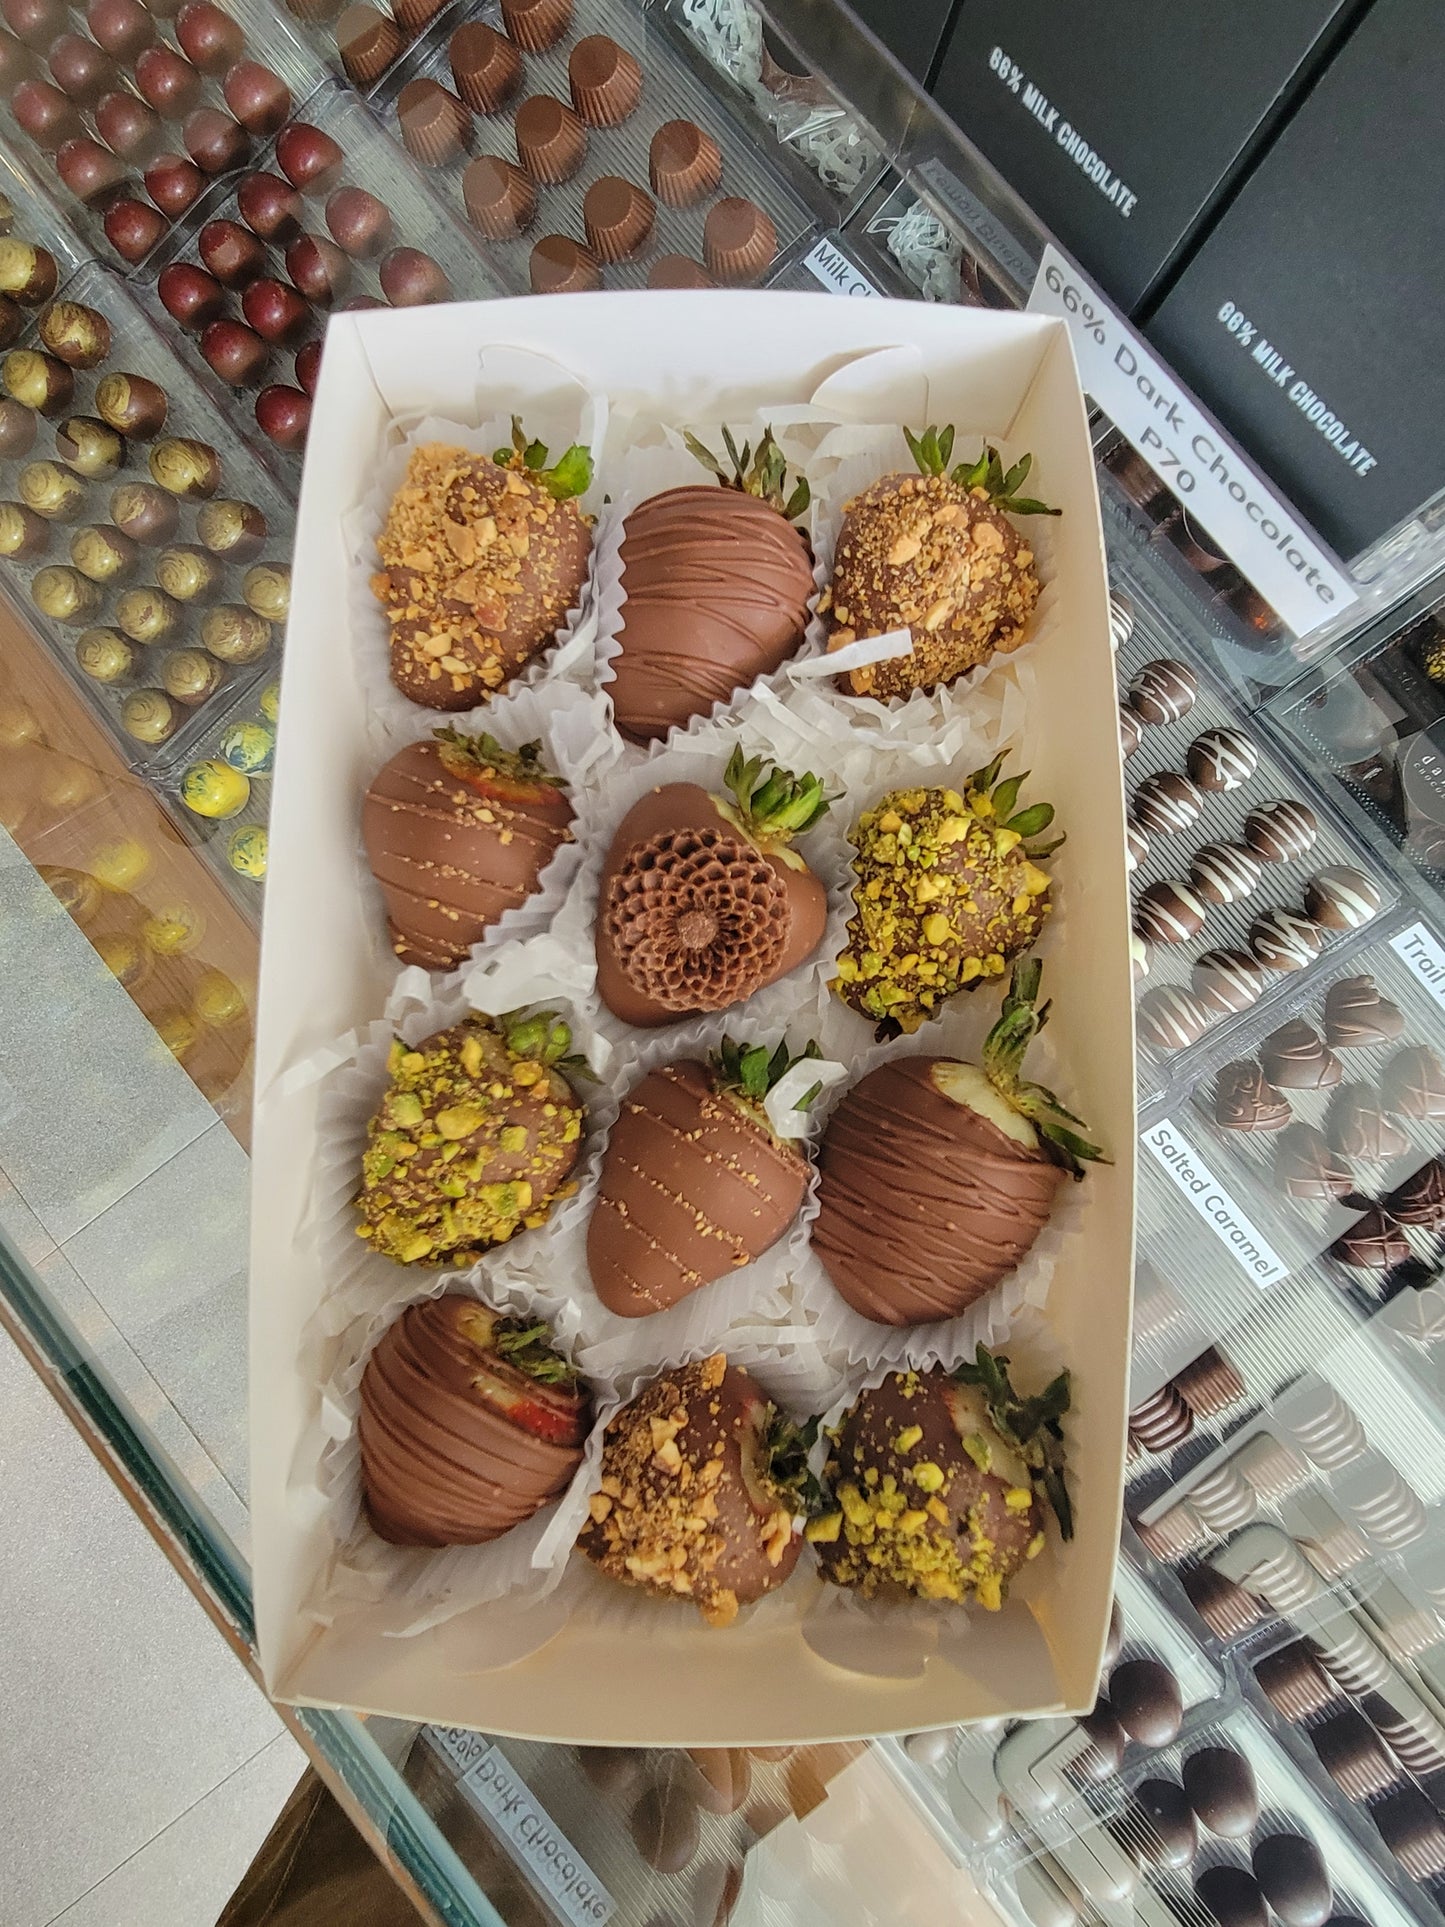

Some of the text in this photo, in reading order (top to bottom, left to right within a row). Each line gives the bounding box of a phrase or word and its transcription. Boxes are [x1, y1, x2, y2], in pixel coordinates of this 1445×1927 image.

[1021, 82, 1060, 133] MILK
[1056, 122, 1138, 218] CHOCOLATE
[813, 243, 851, 287] Milk
[1045, 265, 1106, 345] 66%
[1113, 343, 1186, 434] Dark
[1191, 434, 1336, 605] Chocolate
[1139, 426, 1196, 494] P70
[1251, 339, 1296, 388] MILK
[1288, 381, 1378, 477] CHOCOLATE
[1403, 933, 1445, 984] Trail
[1151, 1129, 1279, 1278] Salted Caramel
